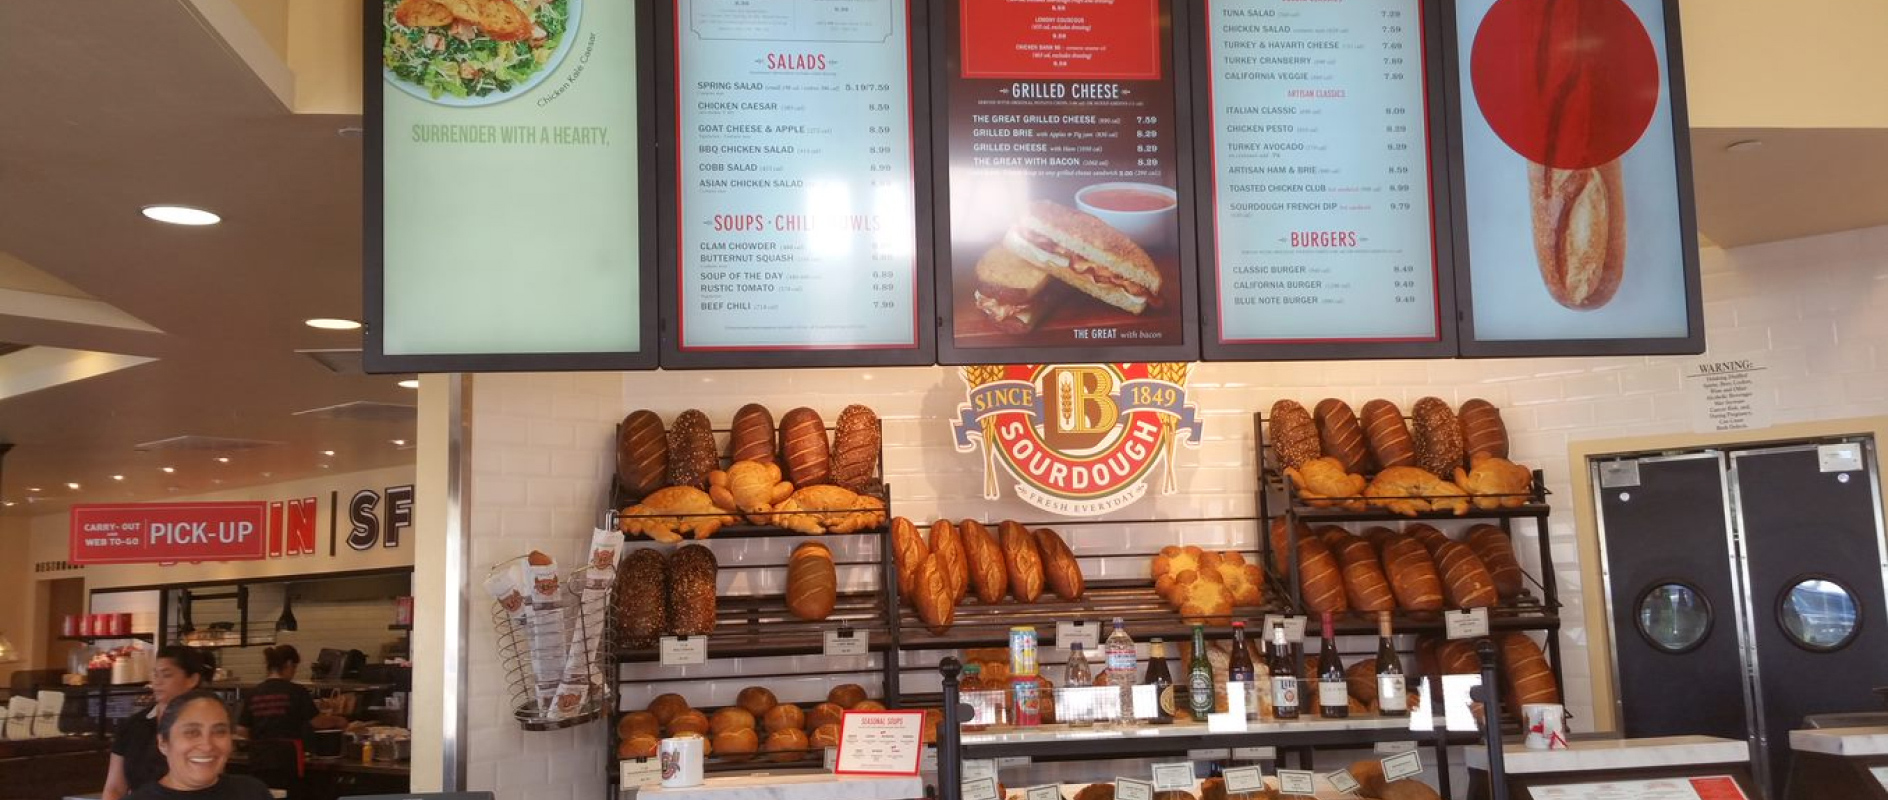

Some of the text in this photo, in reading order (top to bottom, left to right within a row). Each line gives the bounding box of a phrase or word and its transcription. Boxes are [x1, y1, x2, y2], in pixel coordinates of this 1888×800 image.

[768, 54, 826, 70] SALADS
[1260, 57, 1311, 65] CRANBERRY
[1225, 72, 1308, 80] CALIFORNIA VEGGIE
[698, 82, 732, 90] SPRING
[734, 82, 763, 90] SALAD
[1012, 83, 1118, 98] GRILLED CHEESE
[1288, 90, 1346, 98] ARTISAN CLASSICS
[537, 83, 570, 107] Chicken
[698, 102, 738, 110] CHICKEN
[740, 102, 777, 110] CAESAR
[973, 115, 990, 123] THE
[992, 115, 1020, 123] GREAT
[1023, 115, 1060, 123] GRILLED
[1062, 116, 1096, 124] CHEESE
[1137, 116, 1157, 124] 7.59
[698, 125, 724, 133] GOAT
[726, 125, 762, 133] CHEESE
[764, 125, 772, 133] &
[775, 125, 805, 133] APPLE
[973, 129, 1010, 137] GRILLED
[1012, 129, 1033, 137] BRIE
[1227, 125, 1294, 133] CHICKEN PESTO
[412, 124, 610, 146] SURRENDER WITH A HEARTY,
[699, 146, 794, 154] BBQ CHICKEN SALAD
[973, 143, 1010, 151] GRILLED
[1013, 144, 1047, 152] CHEESE
[974, 158, 1080, 166] THE GREAT WITH BACON
[699, 164, 757, 172] COBB SALAD
[1229, 166, 1317, 174] ARTISAN HAM & BRIE
[1229, 184, 1266, 192] TOASTED
[1268, 184, 1304, 192] CHICKEN
[1230, 203, 1284, 211] SOURDOUGH
[1286, 203, 1320, 211] FRENCH
[714, 214, 764, 232] SOUPS
[1291, 231, 1356, 247] BURGERS
[700, 242, 776, 250] CLAM CHOWDER
[700, 254, 794, 263] BUTTERNUT SQUASH
[1233, 266, 1306, 274] CLASSIC BURGER
[700, 272, 784, 280] SOUP OF THE DAY
[701, 284, 774, 292] RUSTIC TOMATO
[1234, 281, 1322, 289] CALIFORNIA BURGER
[1234, 296, 1318, 304] BLUE NOTE BURGER
[701, 302, 751, 310] BEEF CHILI
[1074, 329, 1089, 339] THE
[1091, 329, 1117, 339] GREAT
[1140, 331, 1162, 339] bacon
[974, 388, 1033, 412] SINCE
[1130, 386, 1177, 406] 1849
[1001, 420, 1158, 490] SOURDOUGH
[1029, 492, 1135, 512] FRESH EVERYDAY
[270, 484, 414, 557] IN SF
[150, 522, 253, 545] PICK-UP
[85, 538, 107, 546] WEB
[887, 717, 903, 725] SOUPS
